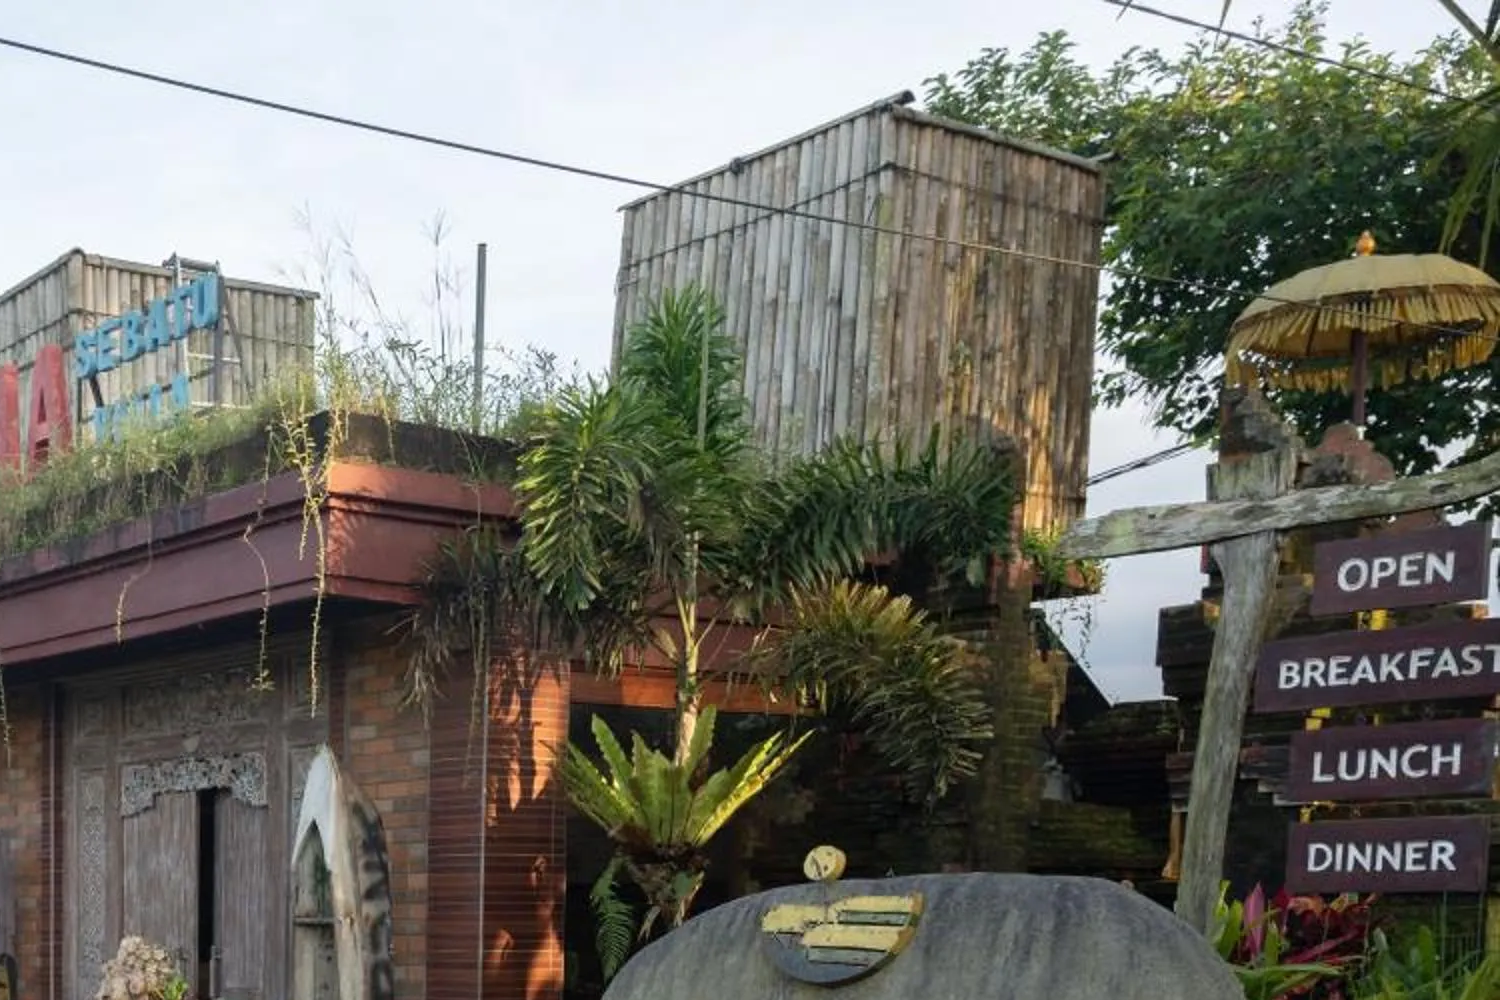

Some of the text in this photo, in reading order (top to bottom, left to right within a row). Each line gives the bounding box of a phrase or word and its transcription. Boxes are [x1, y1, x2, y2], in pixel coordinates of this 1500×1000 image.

[75, 271, 219, 379] SEBATU
[1336, 551, 1456, 593] OPEN
[1277, 643, 1500, 690] BREAKFAST
[1312, 743, 1462, 784] LUNCH
[1306, 840, 1457, 874] DINNER
